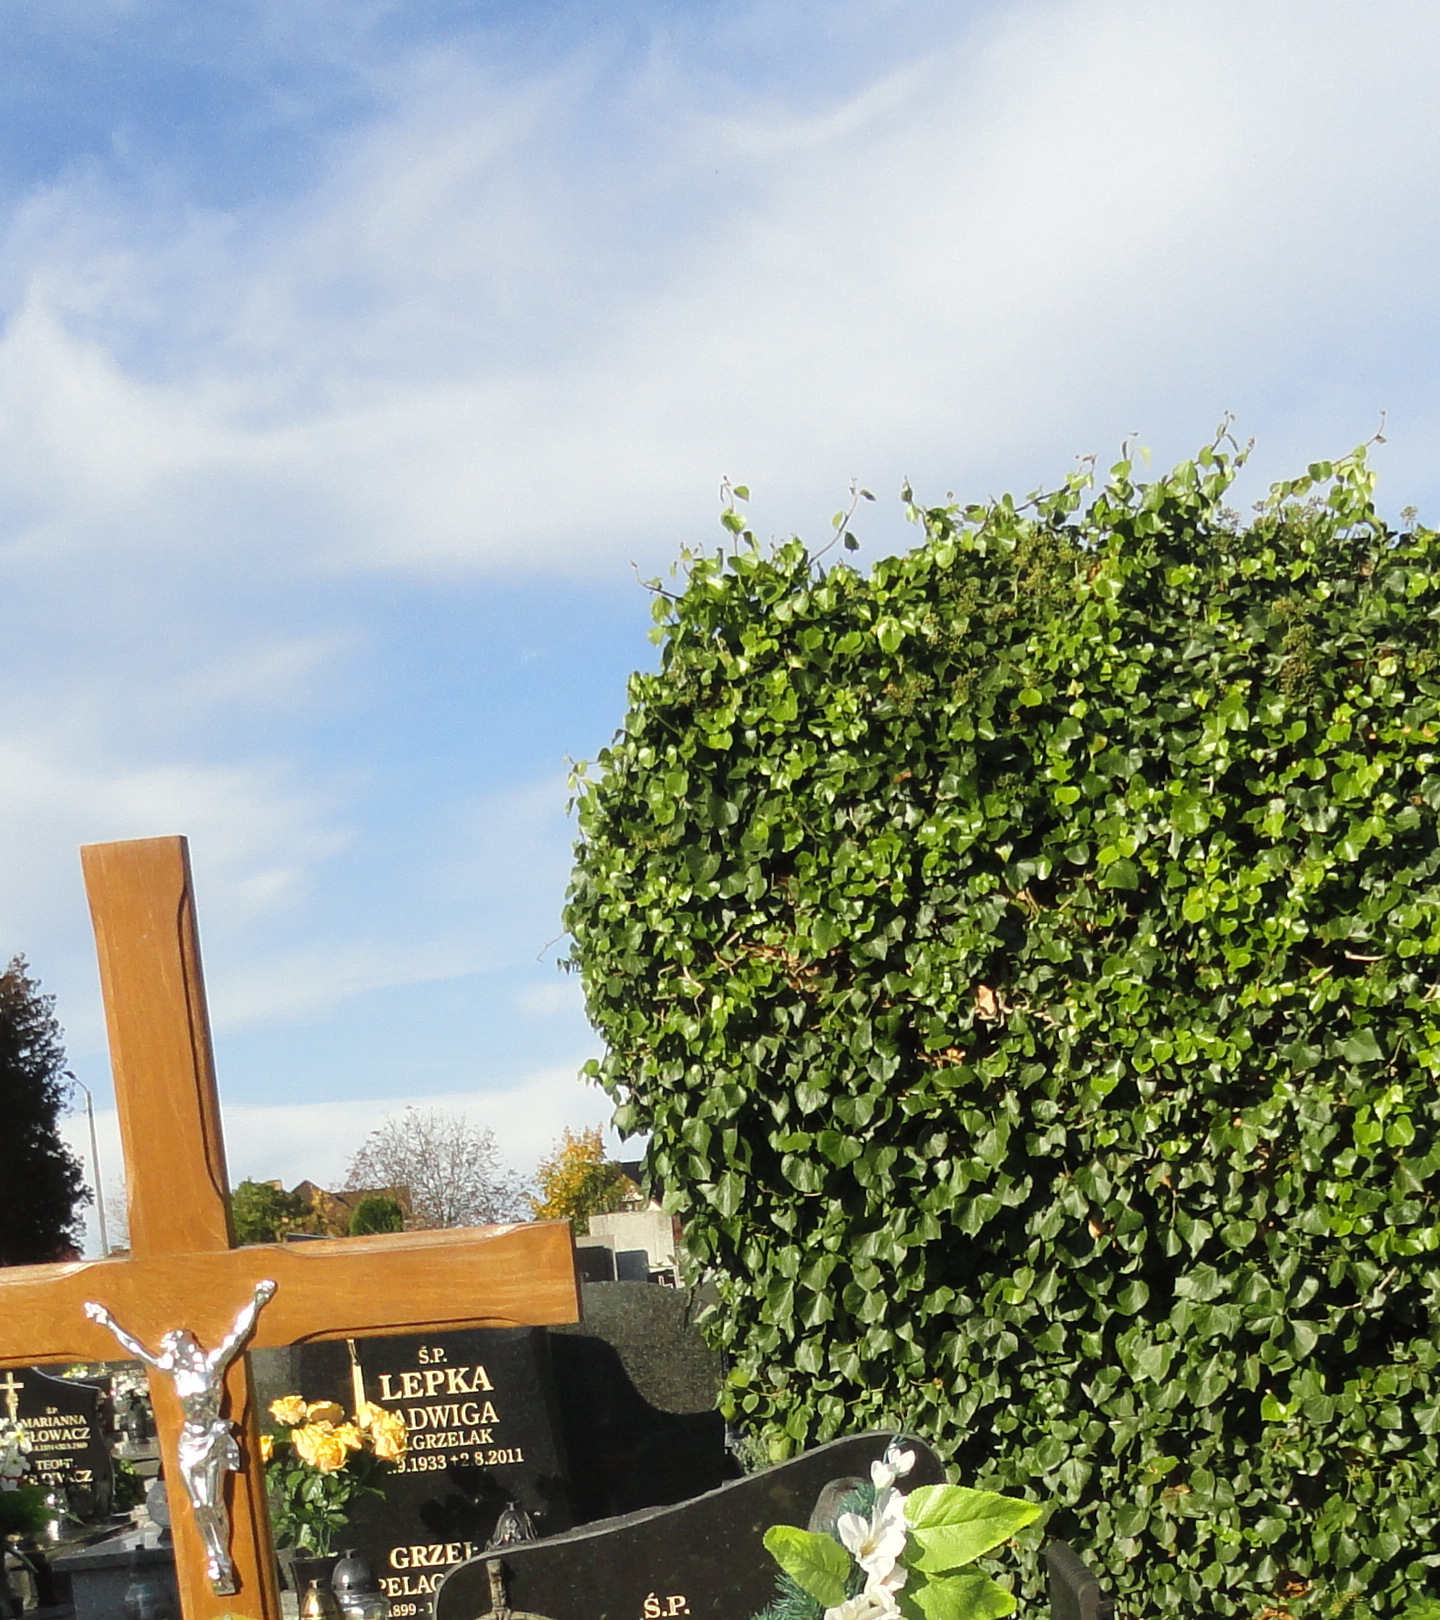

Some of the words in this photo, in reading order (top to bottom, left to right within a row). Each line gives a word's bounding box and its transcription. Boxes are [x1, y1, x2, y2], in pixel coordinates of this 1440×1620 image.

[418, 1346, 448, 1365] Ś.P.
[378, 1365, 494, 1401] LEPKA
[392, 1401, 500, 1431] ADWIGA
[390, 1541, 478, 1570] GRZE
[643, 1592, 692, 1620] Ś.P.
